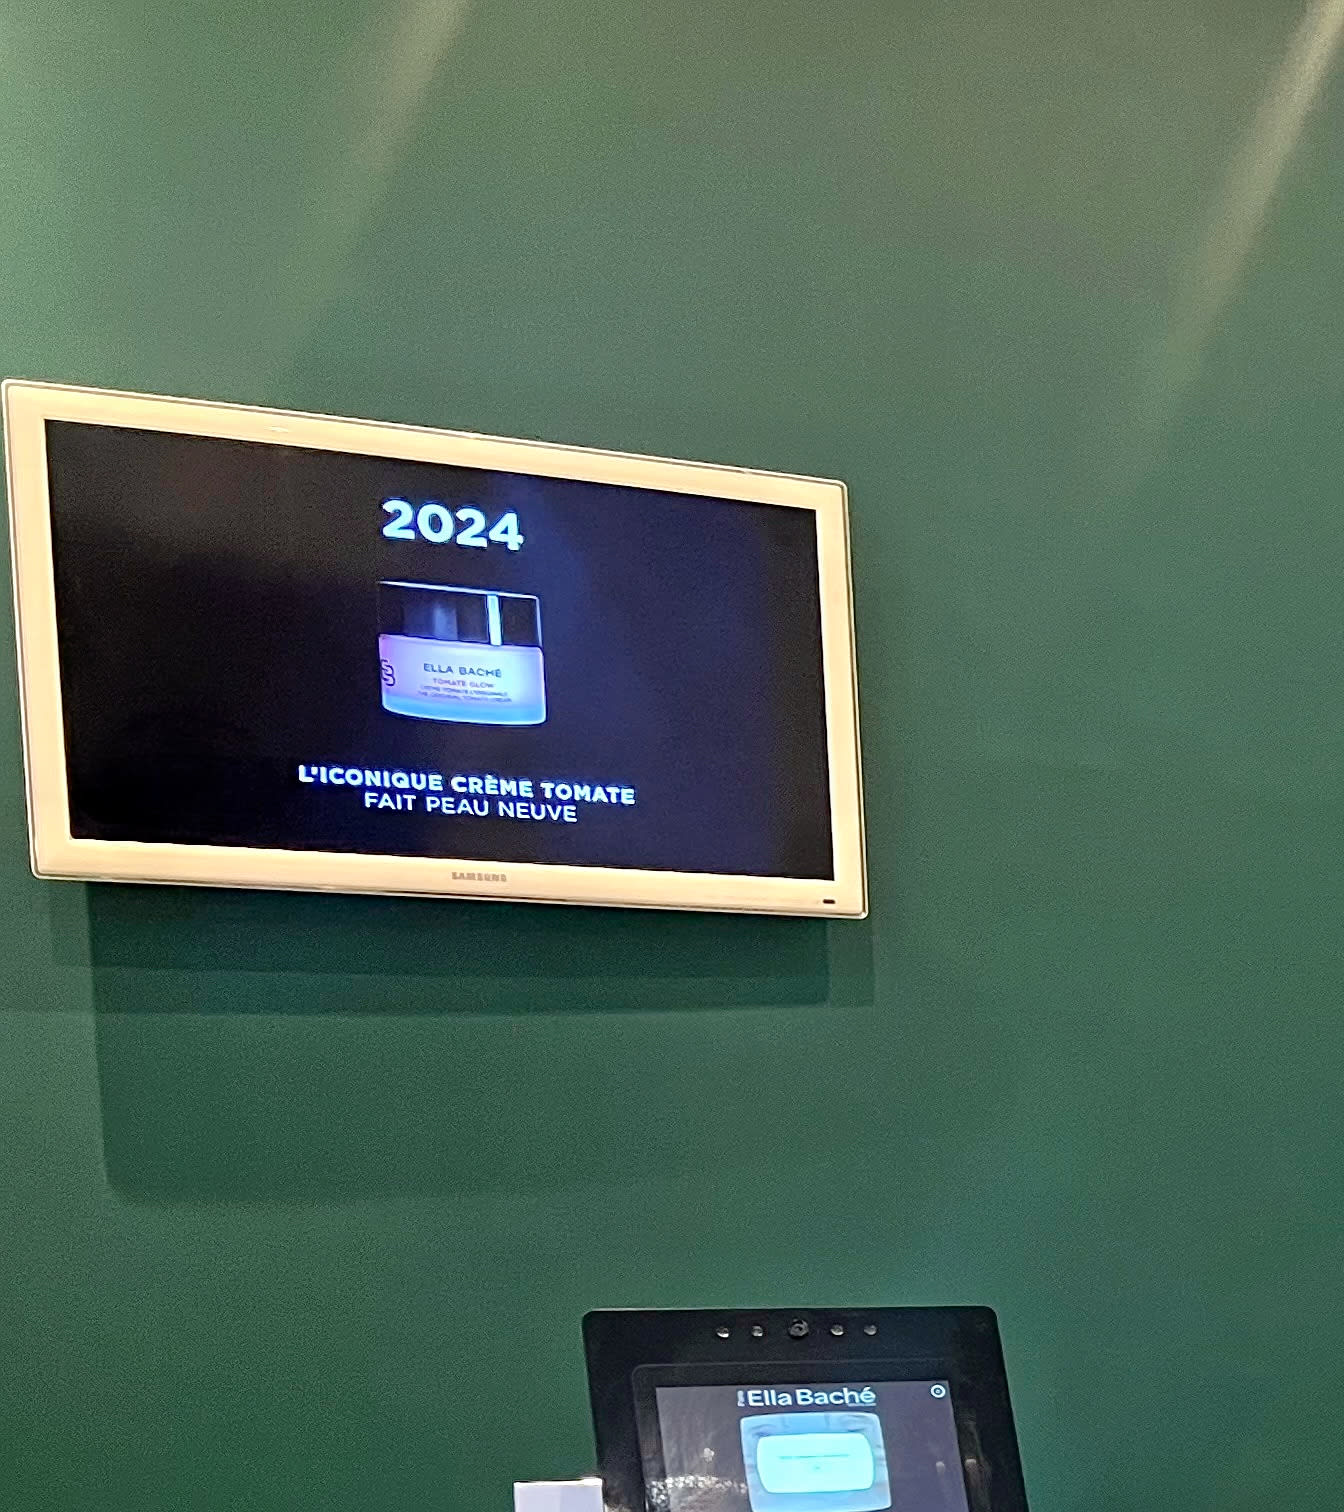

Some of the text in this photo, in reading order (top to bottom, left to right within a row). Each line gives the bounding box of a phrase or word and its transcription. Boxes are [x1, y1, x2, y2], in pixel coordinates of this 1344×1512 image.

[381, 498, 525, 551] 2024
[423, 662, 454, 674] ELLA
[298, 764, 637, 805] L'ICONIQUE CRÈME TOMATE
[364, 791, 578, 823] FAIT PEAU NEUVE
[451, 871, 508, 882] SAMSUNG
[747, 1389, 793, 1407] Ella
[795, 1386, 877, 1406] Baché
